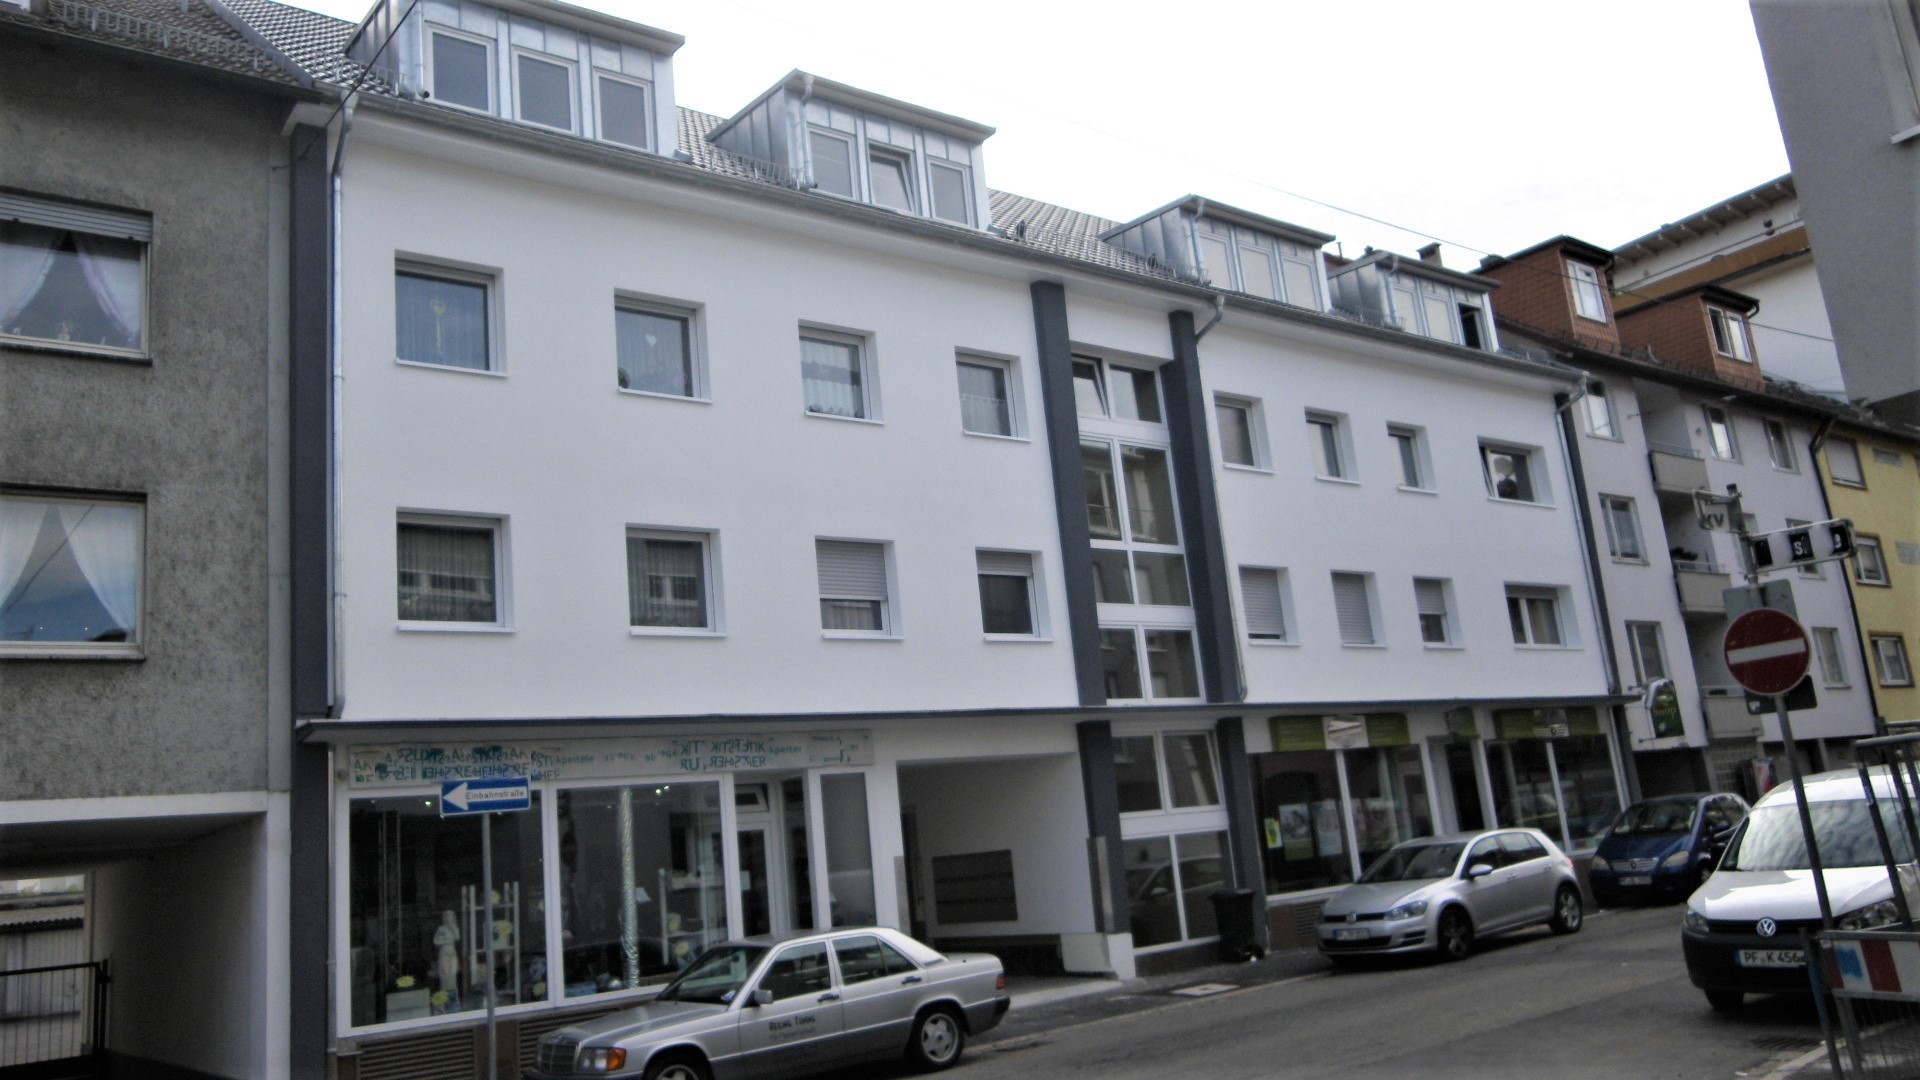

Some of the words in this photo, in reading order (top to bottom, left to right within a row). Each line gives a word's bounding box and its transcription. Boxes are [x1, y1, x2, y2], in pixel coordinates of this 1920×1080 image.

[465, 789, 524, 801] Einbahnstraße
[1744, 951, 1758, 963] PF
[1766, 951, 1775, 963] K
